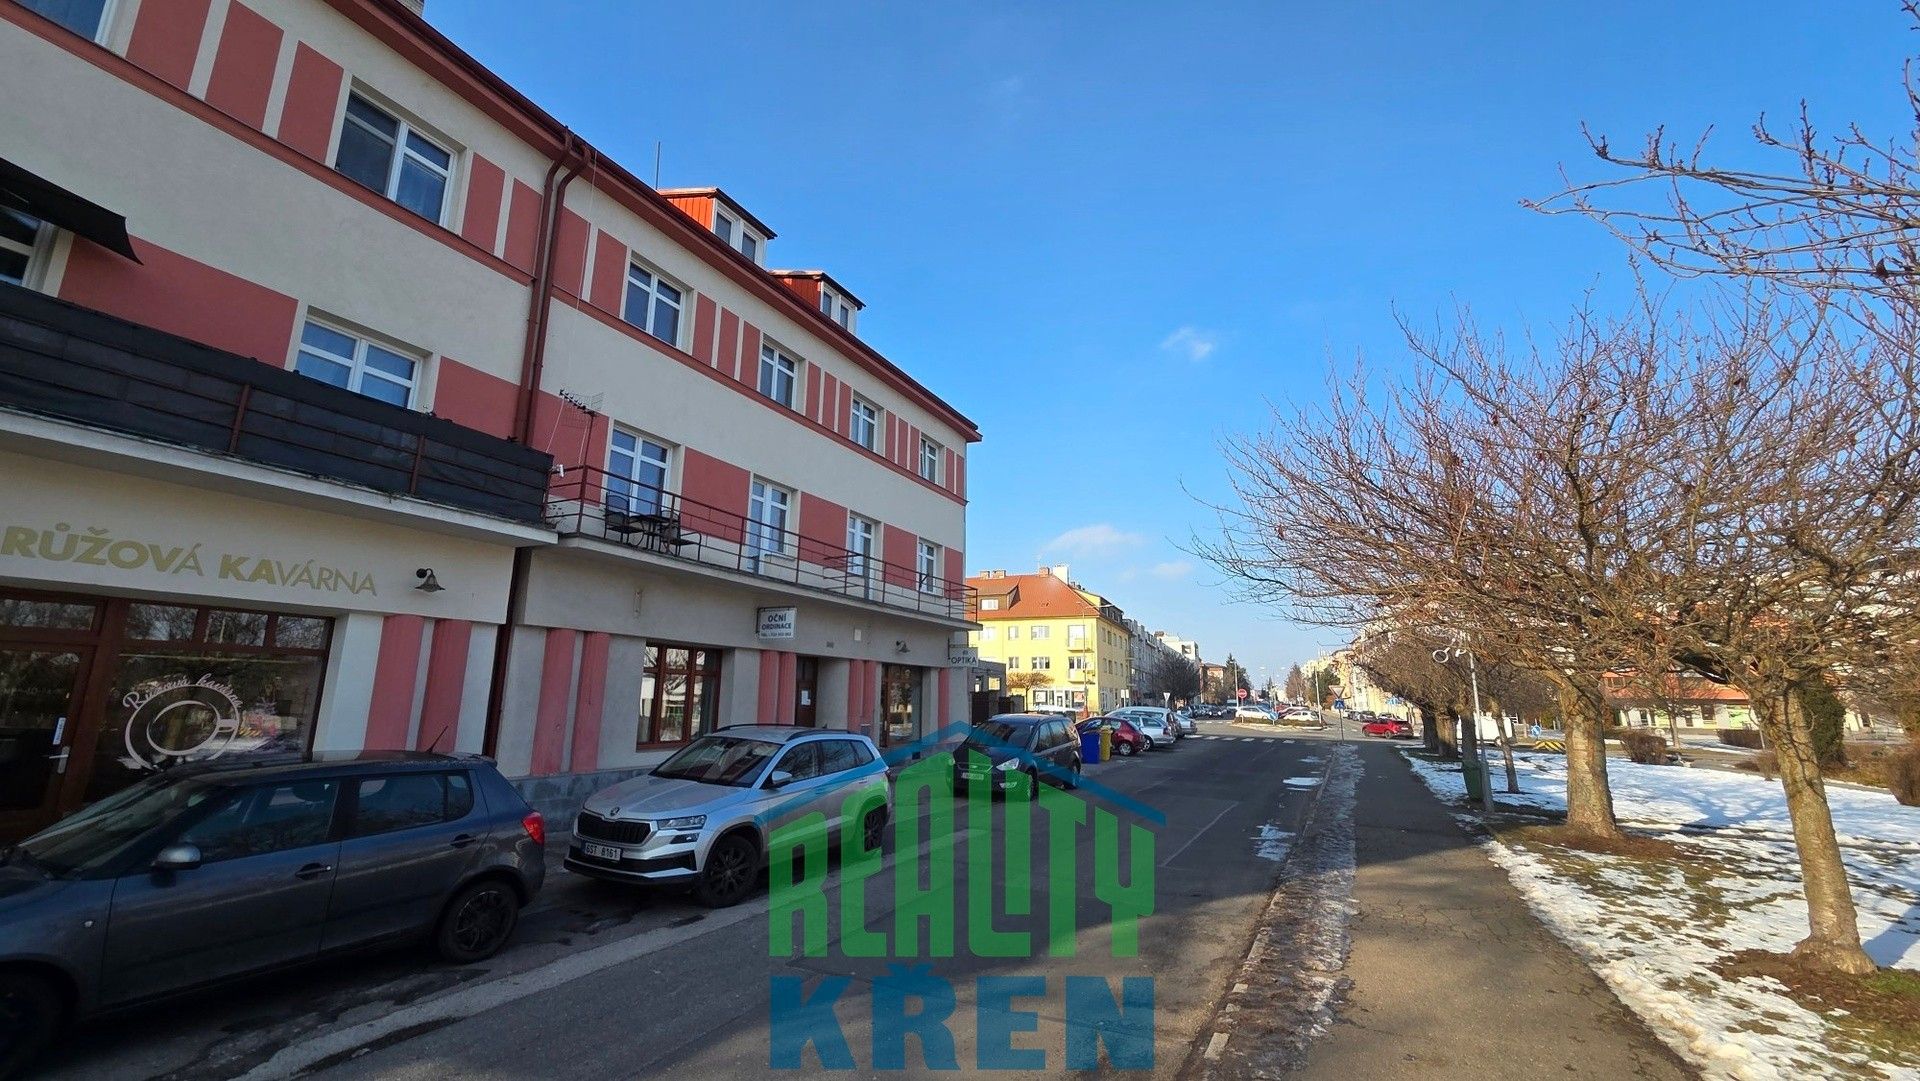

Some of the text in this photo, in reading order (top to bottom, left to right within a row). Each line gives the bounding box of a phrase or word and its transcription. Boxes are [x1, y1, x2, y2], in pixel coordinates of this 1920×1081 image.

[1, 521, 378, 597] RŮŽOVÁ KAVÁRNA
[767, 613, 787, 623] OČNÍ
[761, 622, 792, 631] ORDINACE
[951, 656, 977, 665] OPTIKA
